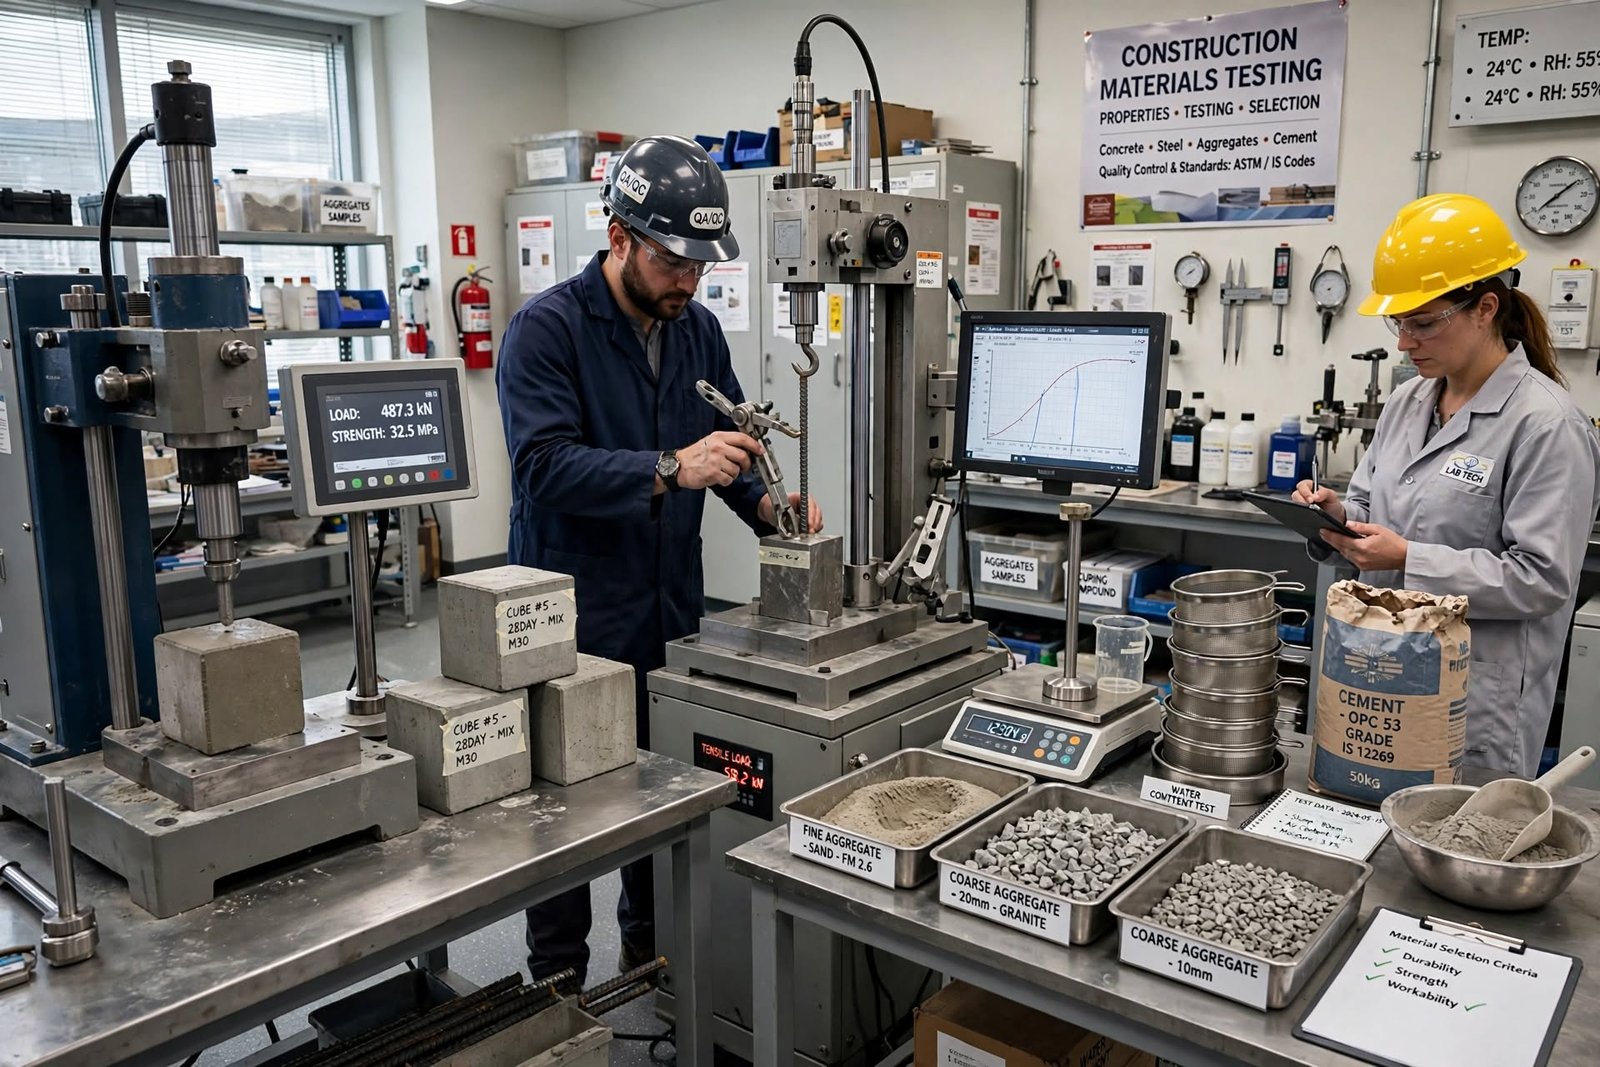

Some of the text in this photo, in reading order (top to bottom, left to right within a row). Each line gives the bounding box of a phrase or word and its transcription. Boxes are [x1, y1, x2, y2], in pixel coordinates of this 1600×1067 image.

[1122, 27, 1298, 67] CONSTRUCTION
[1478, 28, 1530, 48] TEMP:
[1486, 58, 1522, 77] 24°C
[1544, 53, 1571, 71] RH:
[1100, 58, 1322, 100] MATERIALS TESTING
[1485, 88, 1520, 106] 24°C
[1540, 84, 1566, 102] RH:
[1099, 94, 1320, 125] PROPERTIES TESTING SELECTION
[1099, 130, 1318, 156] Concrete Steel Aggregates Cement
[1099, 164, 1131, 179] Quality
[1134, 161, 1168, 175] Control
[1170, 162, 1177, 174] &
[1179, 159, 1231, 173] Standards:
[1233, 157, 1262, 170] ASTM
[1272, 156, 1282, 168] IS
[1284, 154, 1316, 168] Codes
[619, 170, 647, 196] QA/QC
[323, 200, 370, 211] AGGREGATES
[328, 212, 361, 223] SAMPLES
[693, 212, 724, 225] QA/QC
[329, 401, 433, 421] LOAD: 487.3 kN
[332, 423, 439, 443] STRENGTH: 32.5 MPa
[1445, 467, 1484, 483] LAB TECH
[984, 556, 1034, 572] AGGREGATES
[991, 570, 1026, 584] SAMPLES
[507, 604, 532, 618] CUBE
[535, 600, 549, 612] #5
[508, 618, 538, 634] 28DAY
[548, 613, 564, 626] MIX
[508, 635, 529, 650] M30
[1338, 689, 1405, 714] CEMENT
[453, 719, 480, 736] CUBE
[483, 713, 499, 726] #5
[1348, 711, 1378, 728] OPC
[1383, 718, 1401, 732] 53
[455, 732, 487, 752] 28DAY
[497, 725, 515, 739] MIX
[1345, 727, 1393, 747] GRADE
[456, 752, 478, 767] M30
[701, 742, 730, 761] TENSILE
[1342, 741, 1394, 763] IS 12269
[1171, 785, 1201, 799] WATER
[1195, 801, 1216, 814] TEST
[1295, 797, 1313, 806] TEST
[1314, 803, 1334, 812] DATA
[803, 824, 881, 860] FINE AGGREGATE
[808, 842, 834, 859] SAND
[842, 853, 856, 867] FM
[858, 859, 873, 873] 2.6
[949, 871, 1060, 917] COARSE AGGREGATE
[959, 890, 990, 910] 20mm
[999, 904, 1047, 930] GRANITE
[1131, 926, 1259, 978] COARSE AGGREGATE
[1389, 930, 1438, 949] Material
[1493, 960, 1539, 978] Criteria
[1177, 960, 1213, 982] 10mm
[1402, 952, 1462, 976] Durability
[1394, 966, 1449, 988] Strength
[1387, 979, 1459, 1009] Workability
